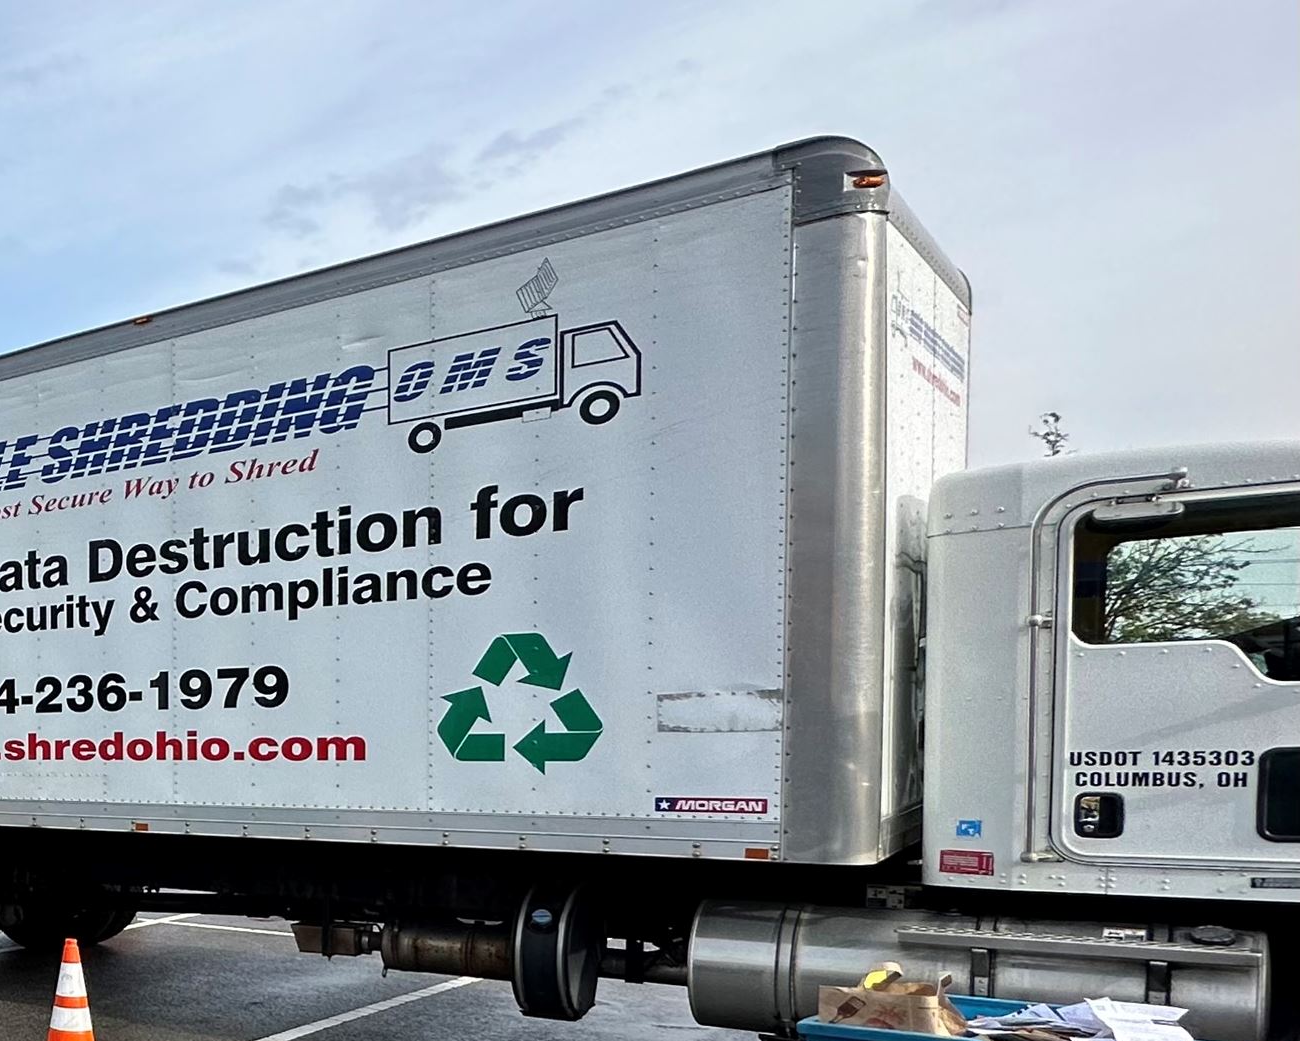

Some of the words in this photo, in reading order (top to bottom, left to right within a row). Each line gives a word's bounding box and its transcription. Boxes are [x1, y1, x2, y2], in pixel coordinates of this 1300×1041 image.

[41, 366, 375, 484] SHREDDING
[28, 488, 113, 516] Secure
[124, 476, 179, 500] Way
[188, 471, 214, 490] to
[225, 449, 320, 484] Shred
[88, 505, 442, 584] Destruction
[469, 484, 585, 540] for
[129, 585, 160, 624] &
[175, 562, 492, 621] Compliance
[1069, 751, 1142, 766] USDOT
[1152, 750, 1255, 766] 1435303
[1074, 771, 1204, 789] COLUMBUS,
[1216, 771, 1248, 787] OH
[674, 799, 763, 812] MORGAN
